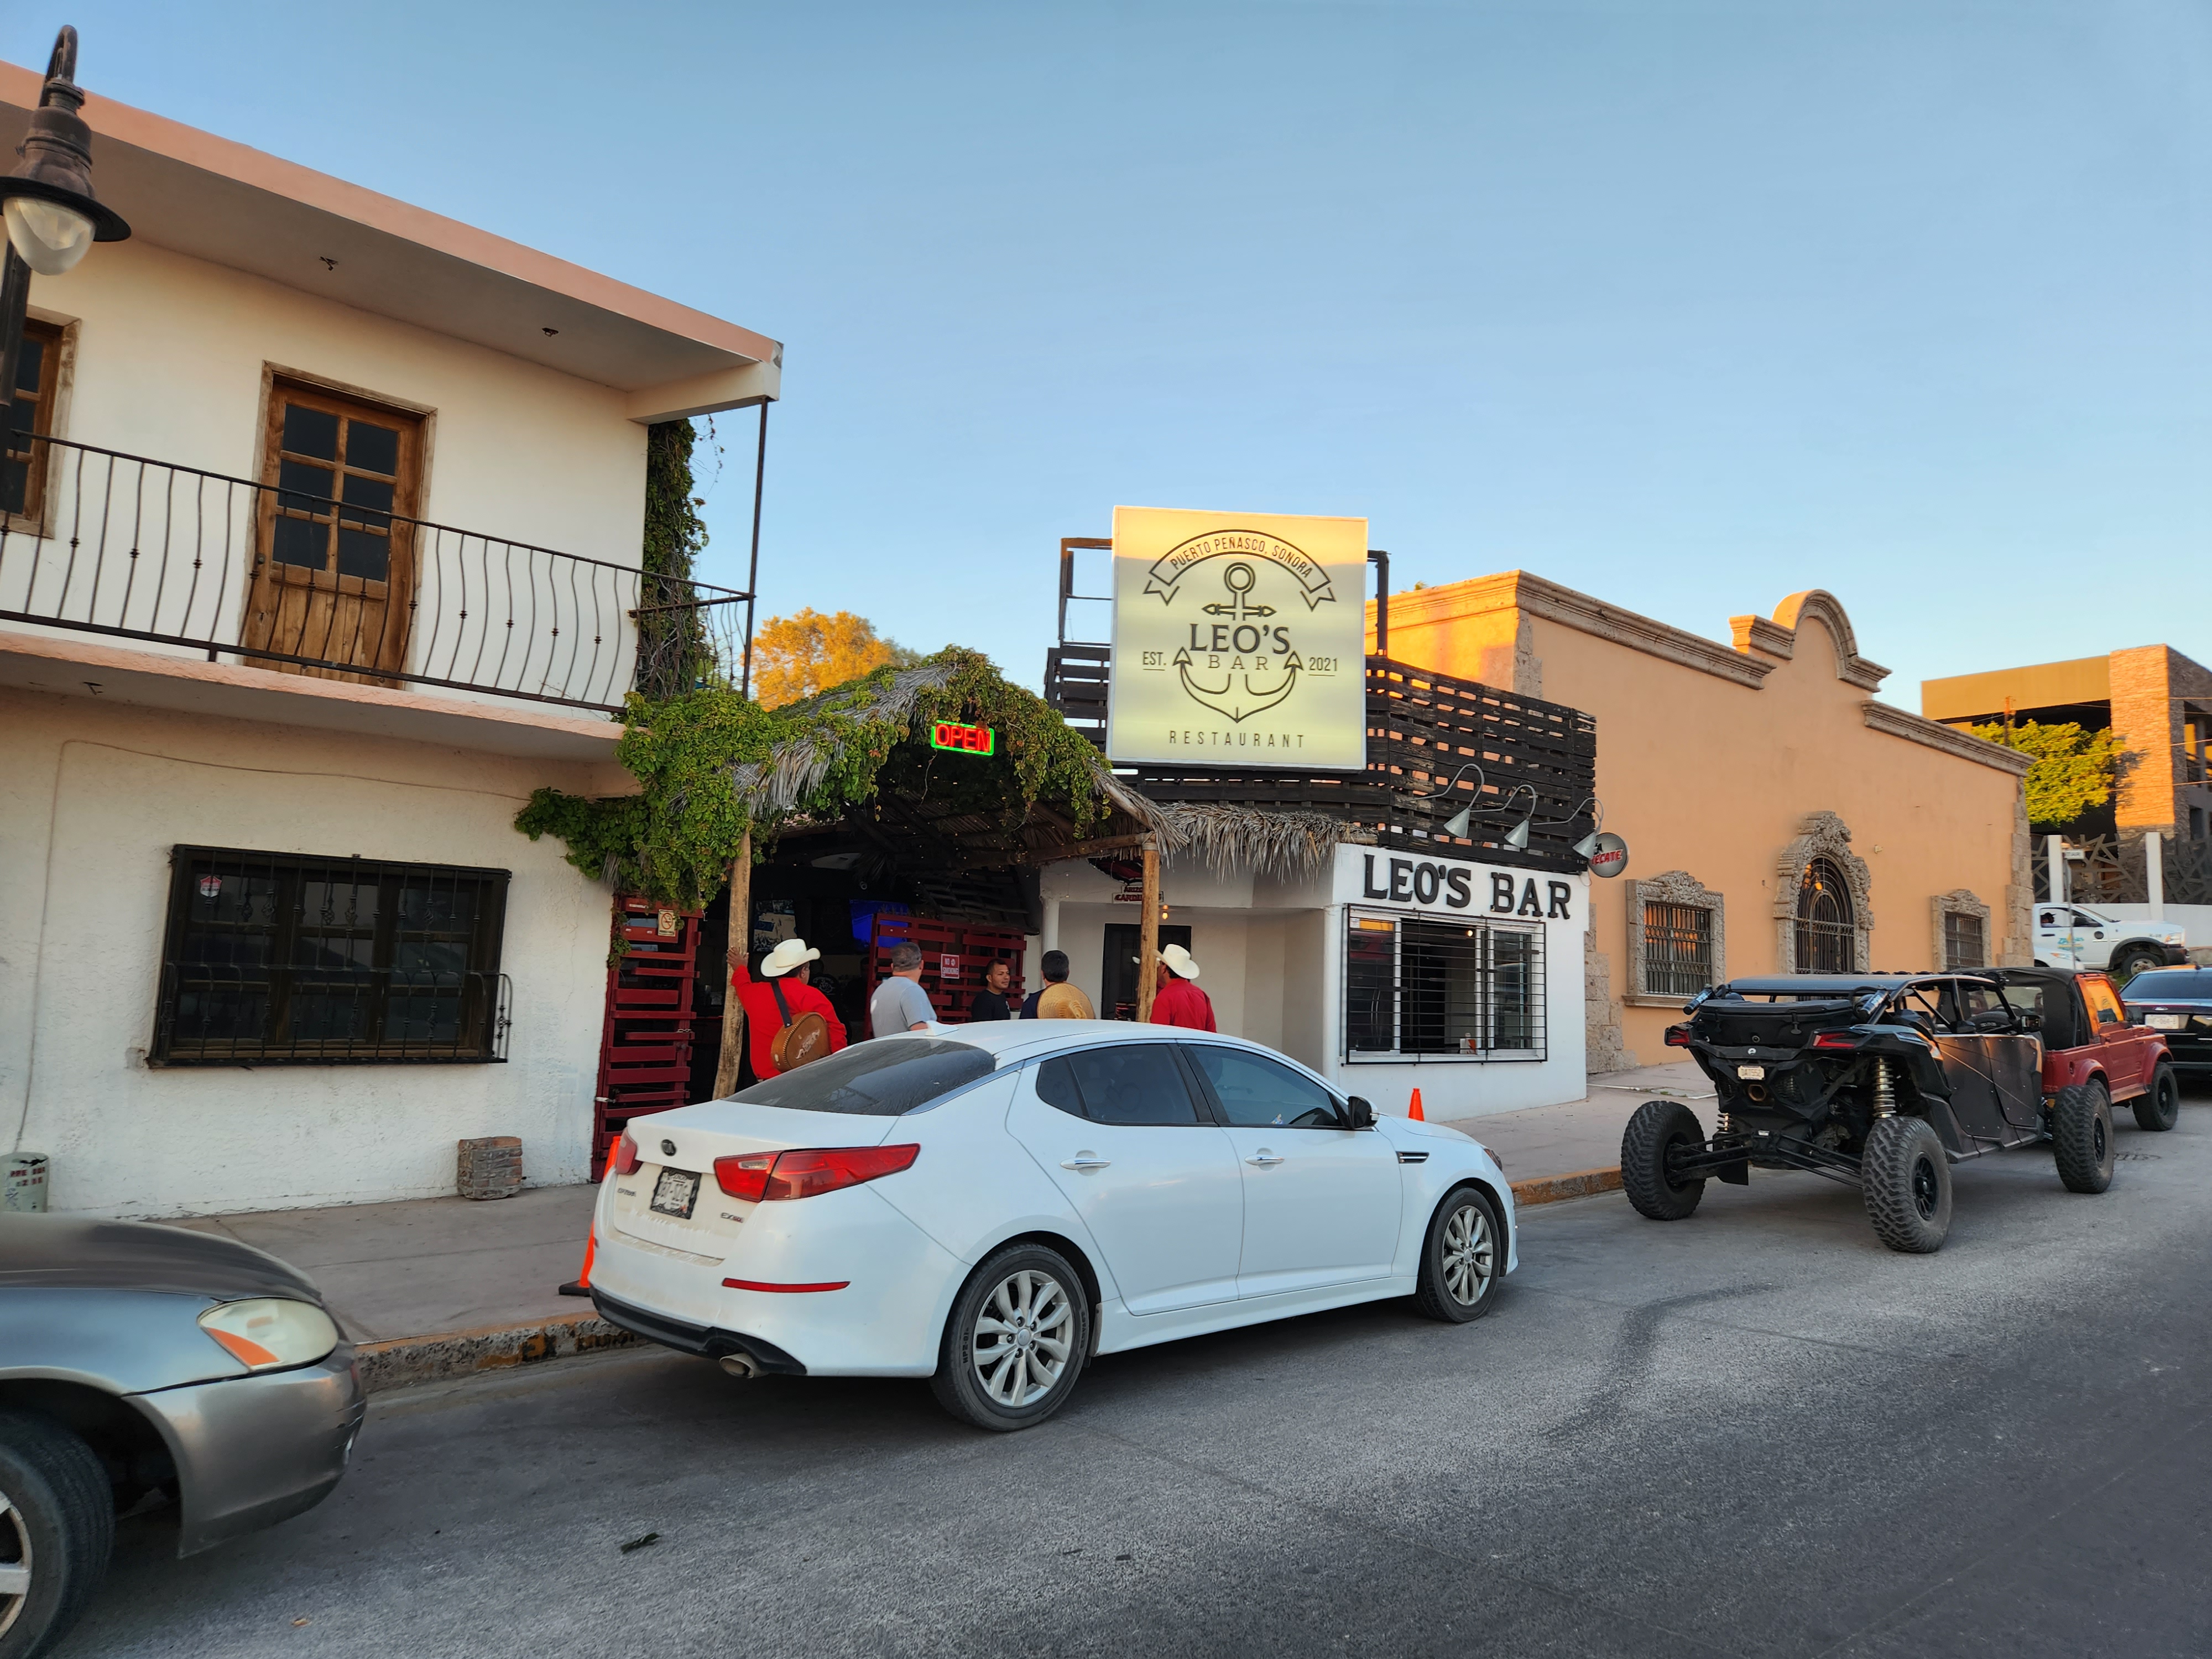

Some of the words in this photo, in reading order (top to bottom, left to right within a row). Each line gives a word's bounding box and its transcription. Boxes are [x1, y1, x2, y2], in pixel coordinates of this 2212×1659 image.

[1171, 541, 1211, 570] PUERTO
[1214, 537, 1267, 555] PEÑASCO,
[1272, 545, 1313, 578] SONORA
[1190, 623, 1290, 654] LEO'S
[1142, 651, 1167, 666] EST.
[1208, 655, 1269, 671] BAR
[1309, 656, 1338, 671] 2021
[935, 724, 990, 752] OPEN
[1169, 730, 1304, 748] RESTAURANT
[1589, 849, 1623, 865] TECATE
[1363, 854, 1471, 909] LEO'S
[1490, 872, 1571, 920] BAR
